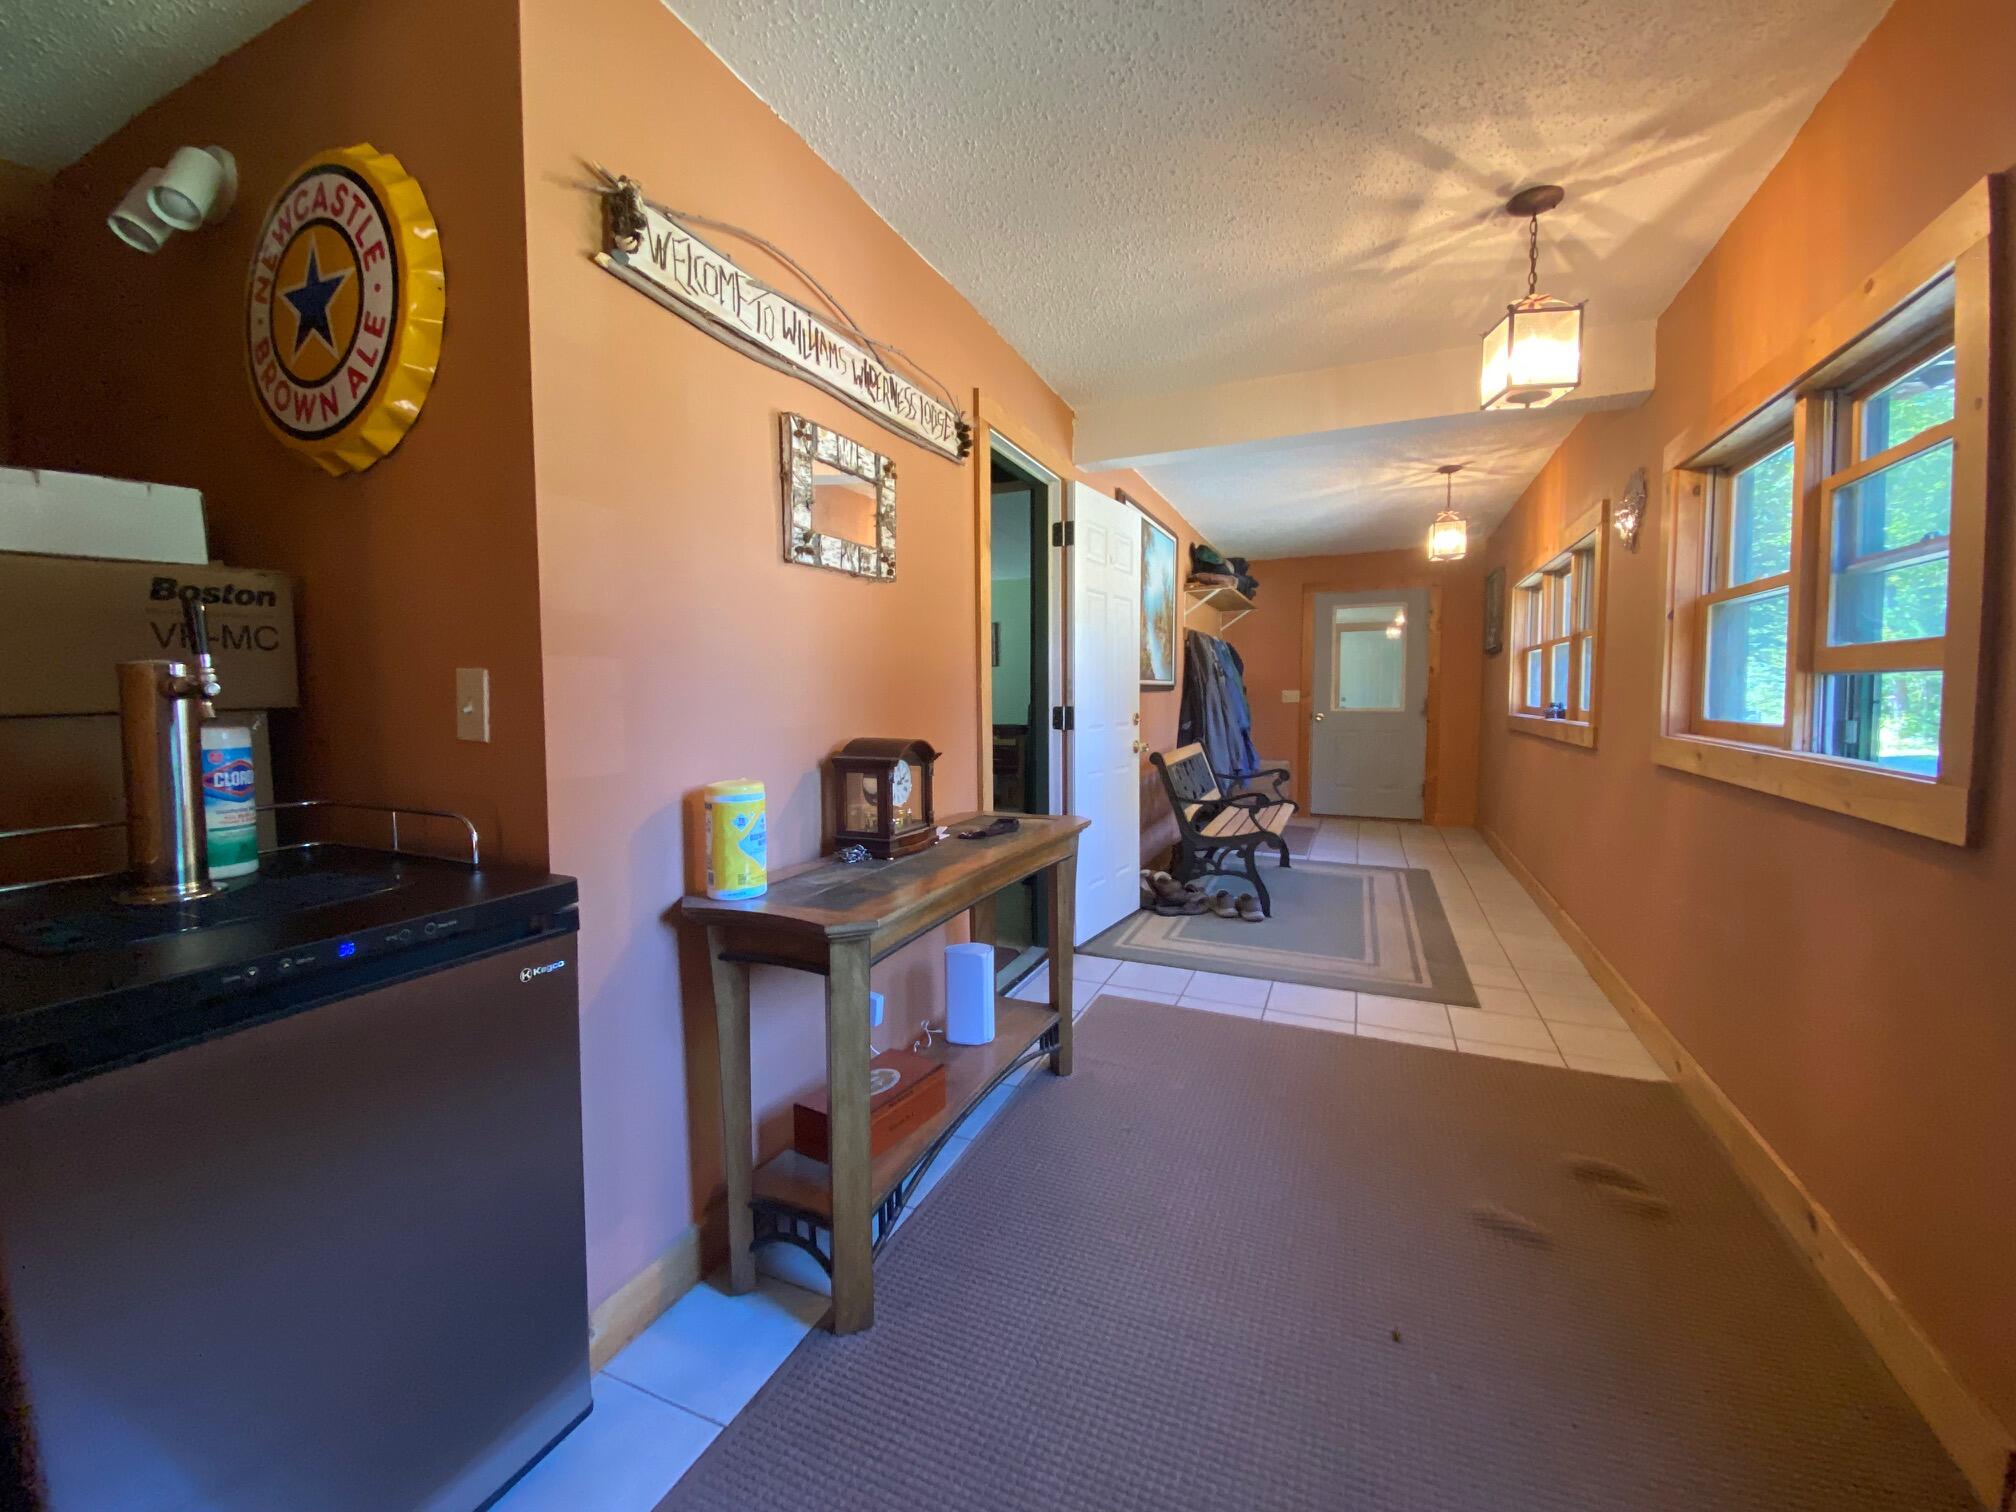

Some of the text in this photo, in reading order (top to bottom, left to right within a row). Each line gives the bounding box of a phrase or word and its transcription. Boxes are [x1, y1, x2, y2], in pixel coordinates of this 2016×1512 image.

[254, 181, 386, 305] NEWCASTLE
[253, 310, 387, 425] BROWN ALE
[645, 217, 753, 331] WELCOME
[748, 292, 775, 341] TO
[782, 306, 847, 376] WILLIAMS
[919, 395, 952, 442] LODGE
[150, 576, 278, 608] Boston
[533, 960, 566, 976] Kegco
